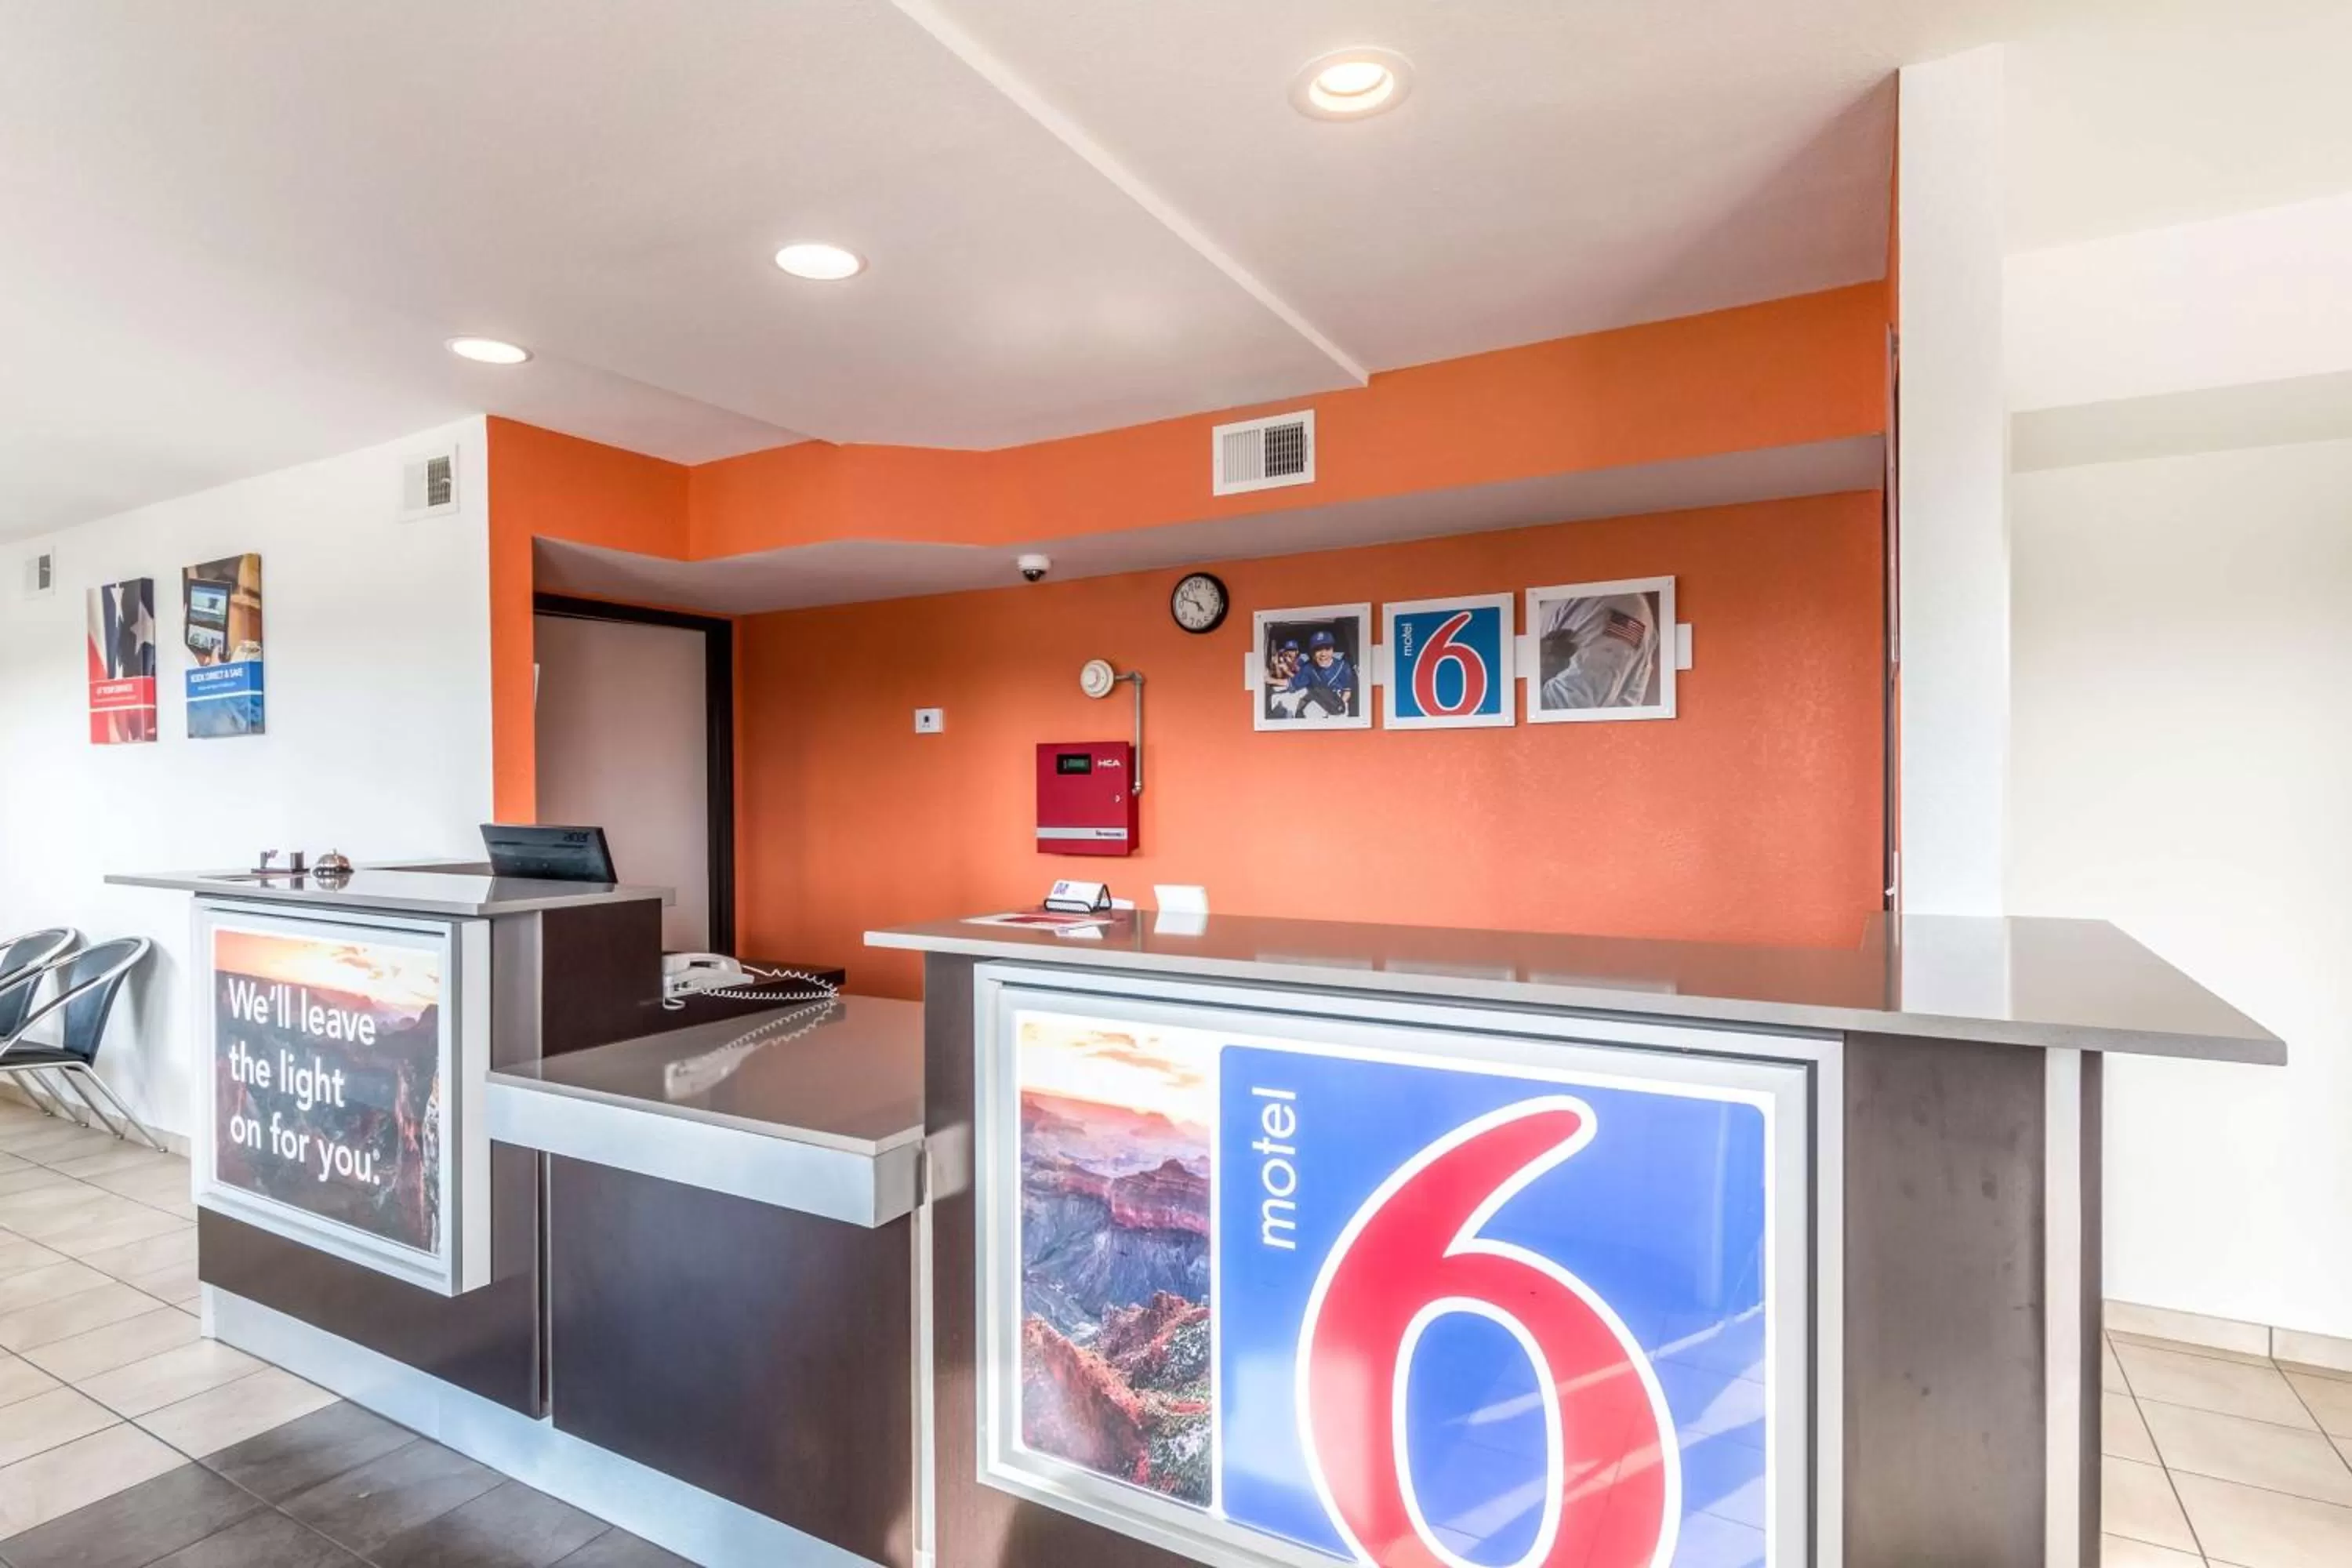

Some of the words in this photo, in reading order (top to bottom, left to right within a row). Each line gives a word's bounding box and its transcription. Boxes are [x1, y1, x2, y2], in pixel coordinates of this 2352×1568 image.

[1401, 623, 1413, 657] motel
[1412, 611, 1488, 717] 6
[563, 832, 590, 843] acer
[228, 978, 292, 1030] We'll
[300, 987, 376, 1046] leave
[228, 1040, 271, 1088] the
[280, 1049, 346, 1111] light
[230, 1114, 262, 1150] on
[269, 1112, 310, 1163] for
[1250, 1087, 1297, 1250] motel
[1294, 1094, 1682, 1568] 6
